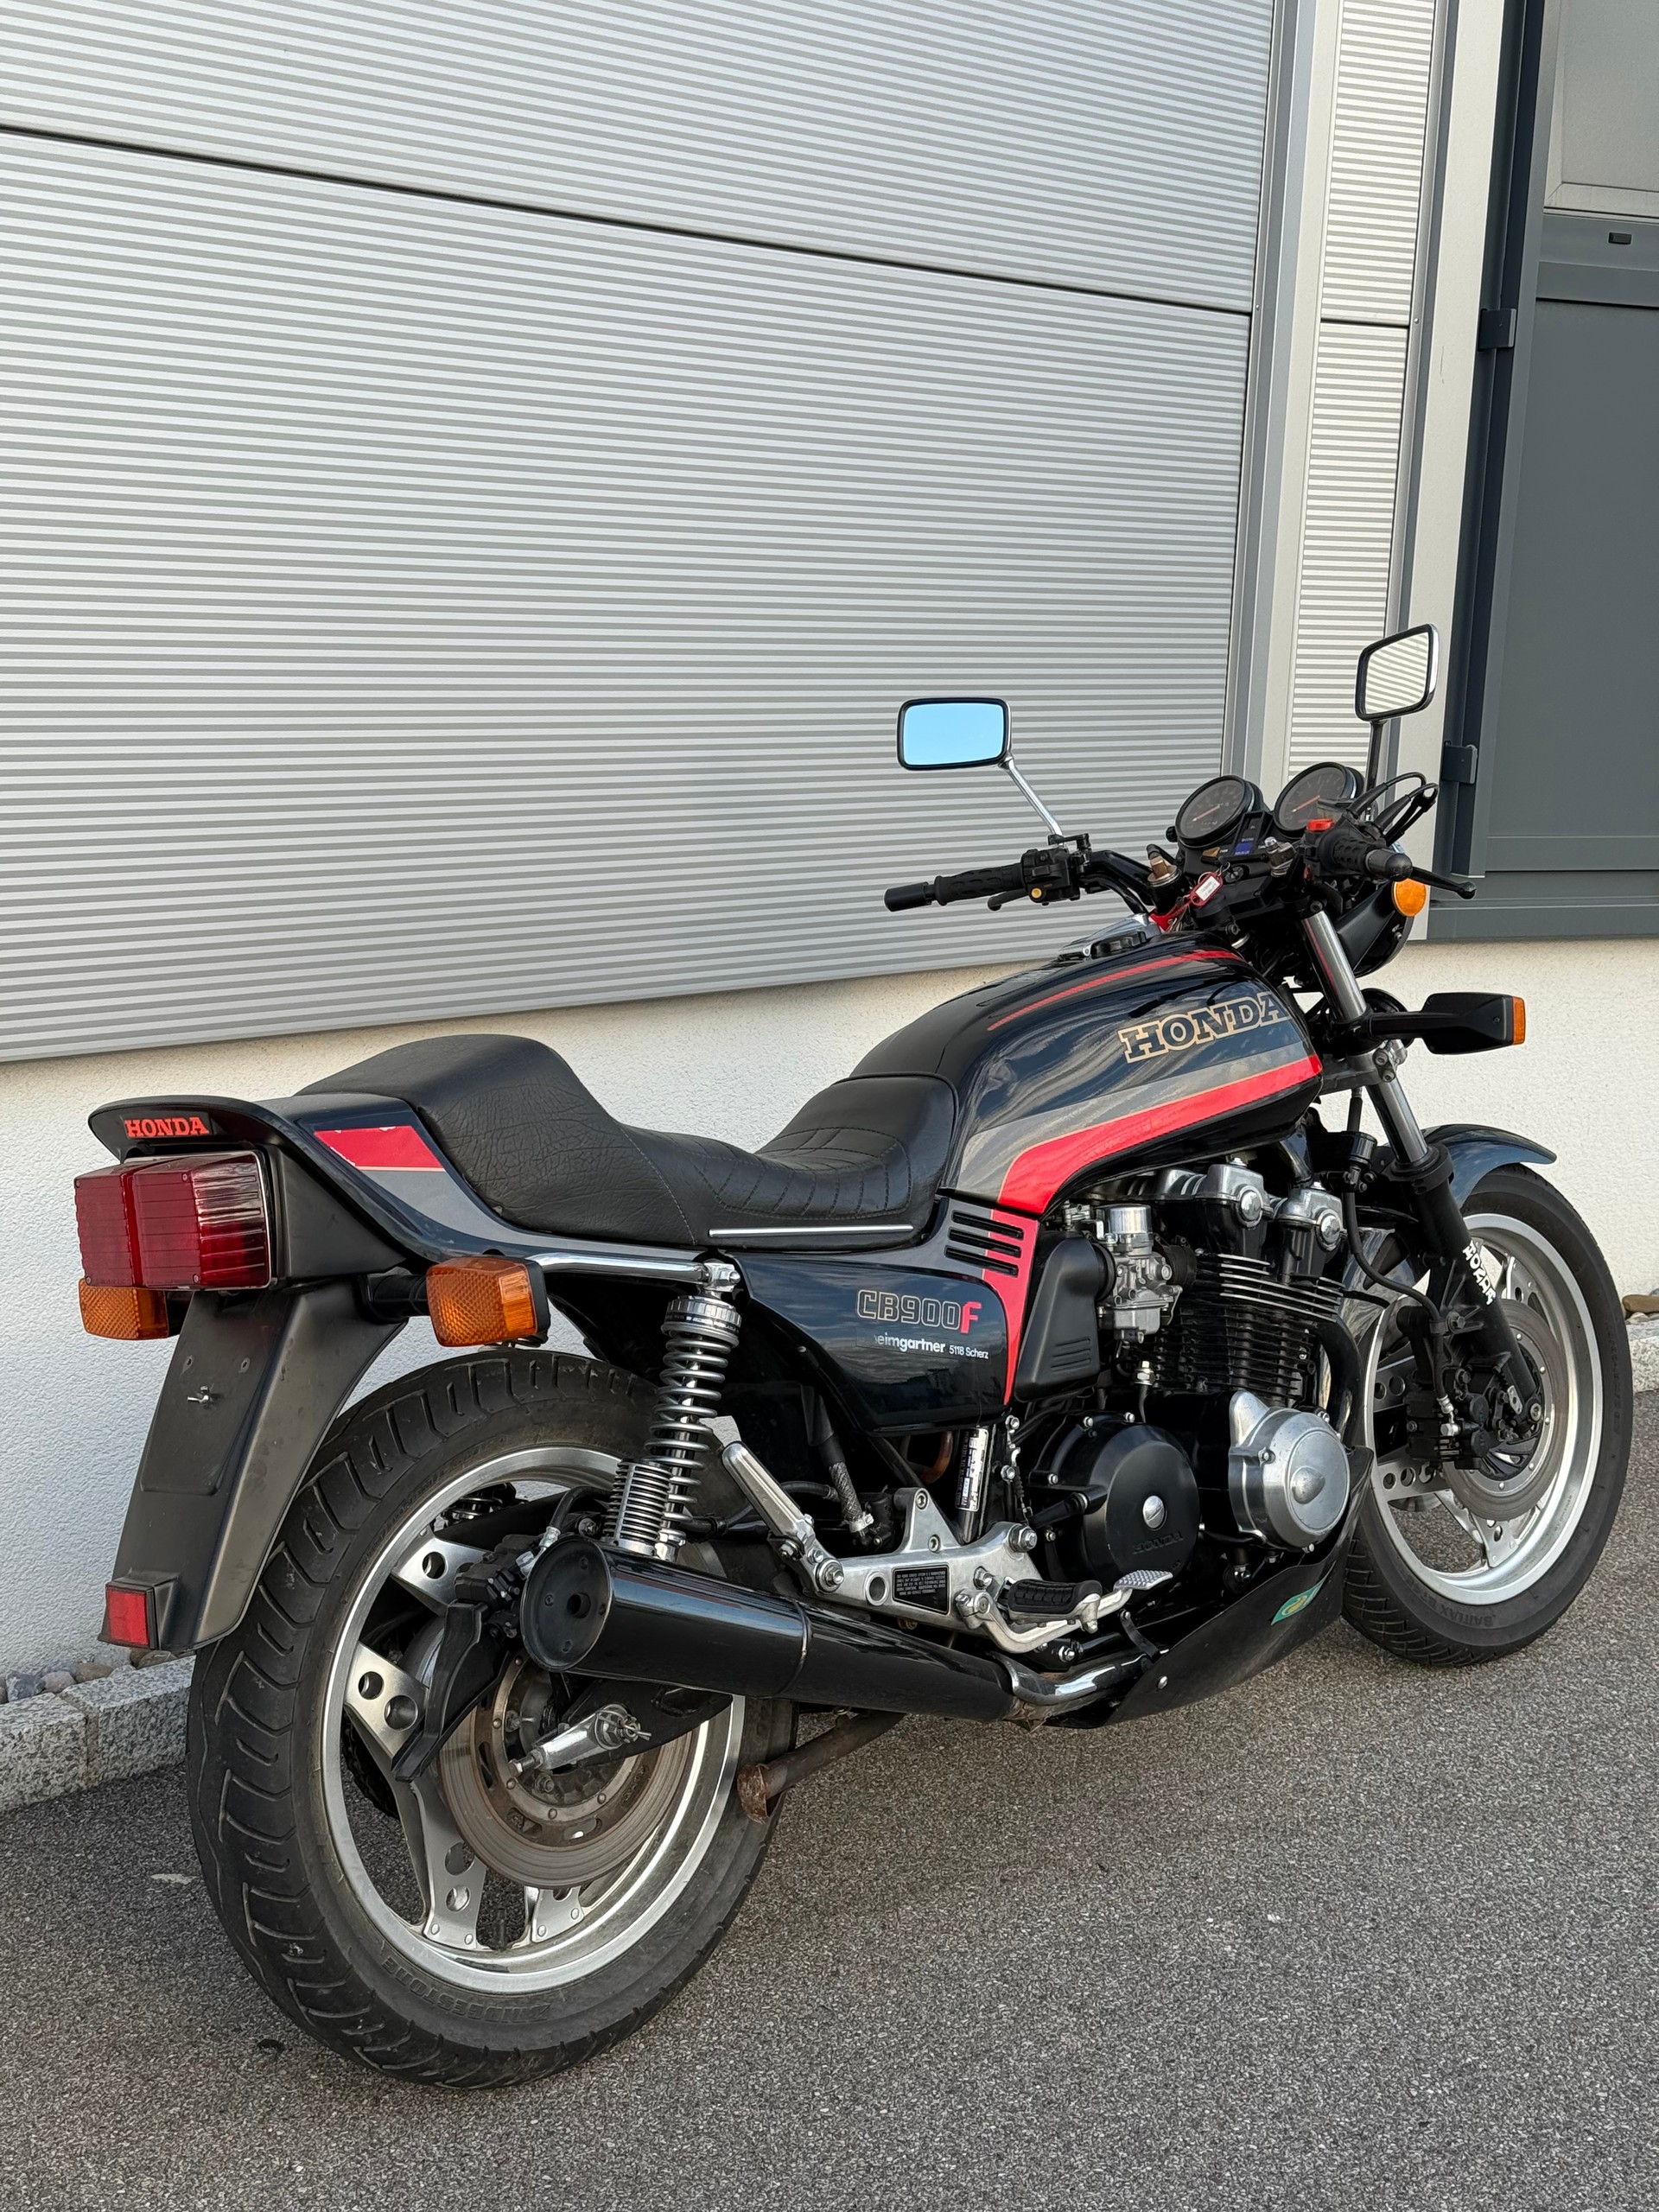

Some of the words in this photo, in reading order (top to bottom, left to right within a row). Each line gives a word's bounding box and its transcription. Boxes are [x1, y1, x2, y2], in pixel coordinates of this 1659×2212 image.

[1117, 991, 1291, 1064] HONDA
[124, 1116, 210, 1138] HONDA
[1462, 1239, 1497, 1306] HONDA
[856, 1289, 982, 1334] CB900F
[874, 1332, 945, 1353] eimgartner
[965, 1346, 989, 1360] Scherz
